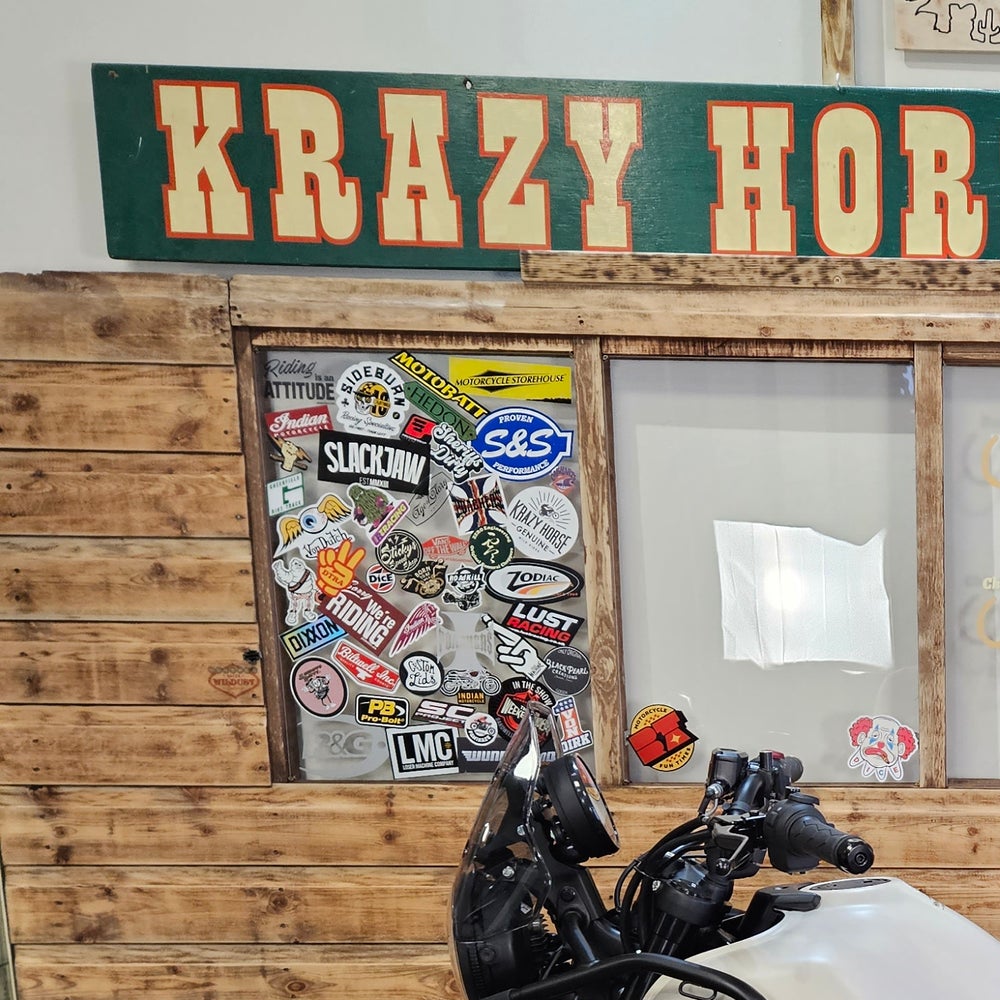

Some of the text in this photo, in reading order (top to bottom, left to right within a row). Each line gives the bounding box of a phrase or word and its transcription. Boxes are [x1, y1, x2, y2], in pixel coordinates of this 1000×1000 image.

[153, 79, 642, 251] KRAZY
[264, 358, 317, 379] Riding
[455, 374, 565, 387] MOTORCYCLE STOREHOUSE
[264, 381, 335, 400] ATTITUDE
[341, 366, 405, 407] SIDEBURN
[396, 352, 488, 419] MOTOBATT
[269, 412, 329, 432] Indian
[410, 386, 470, 437] HEDON
[499, 414, 534, 424] PROVEN
[482, 428, 554, 458] S&S
[324, 441, 426, 485] SLACKJAW
[492, 460, 550, 475] PERFORMANCE
[510, 499, 543, 530] KRAZY
[541, 522, 572, 554] HORSE
[516, 526, 549, 551] GENUINE
[507, 571, 560, 592] ZODIAC
[325, 593, 390, 648] RIDING
[365, 598, 396, 630] We're
[512, 602, 578, 631] LUST
[288, 619, 340, 652] DIXXON
[506, 617, 571, 643] RACING
[337, 646, 379, 675] Biltwell
[408, 659, 435, 674] CUSTOM
[409, 673, 437, 689] Lids
[512, 681, 520, 690] IN
[521, 681, 535, 692] THE
[533, 685, 554, 707] SHOW
[360, 714, 402, 725] Pro-Bolt
[368, 699, 396, 716] PB
[415, 712, 467, 724] PROJECT
[418, 700, 476, 717] SC
[634, 707, 668, 729] MOTORCYCLE
[562, 708, 577, 739] VON
[397, 731, 451, 766] LMC
[675, 747, 692, 765] TIMES
[434, 760, 454, 768] COMPANY
